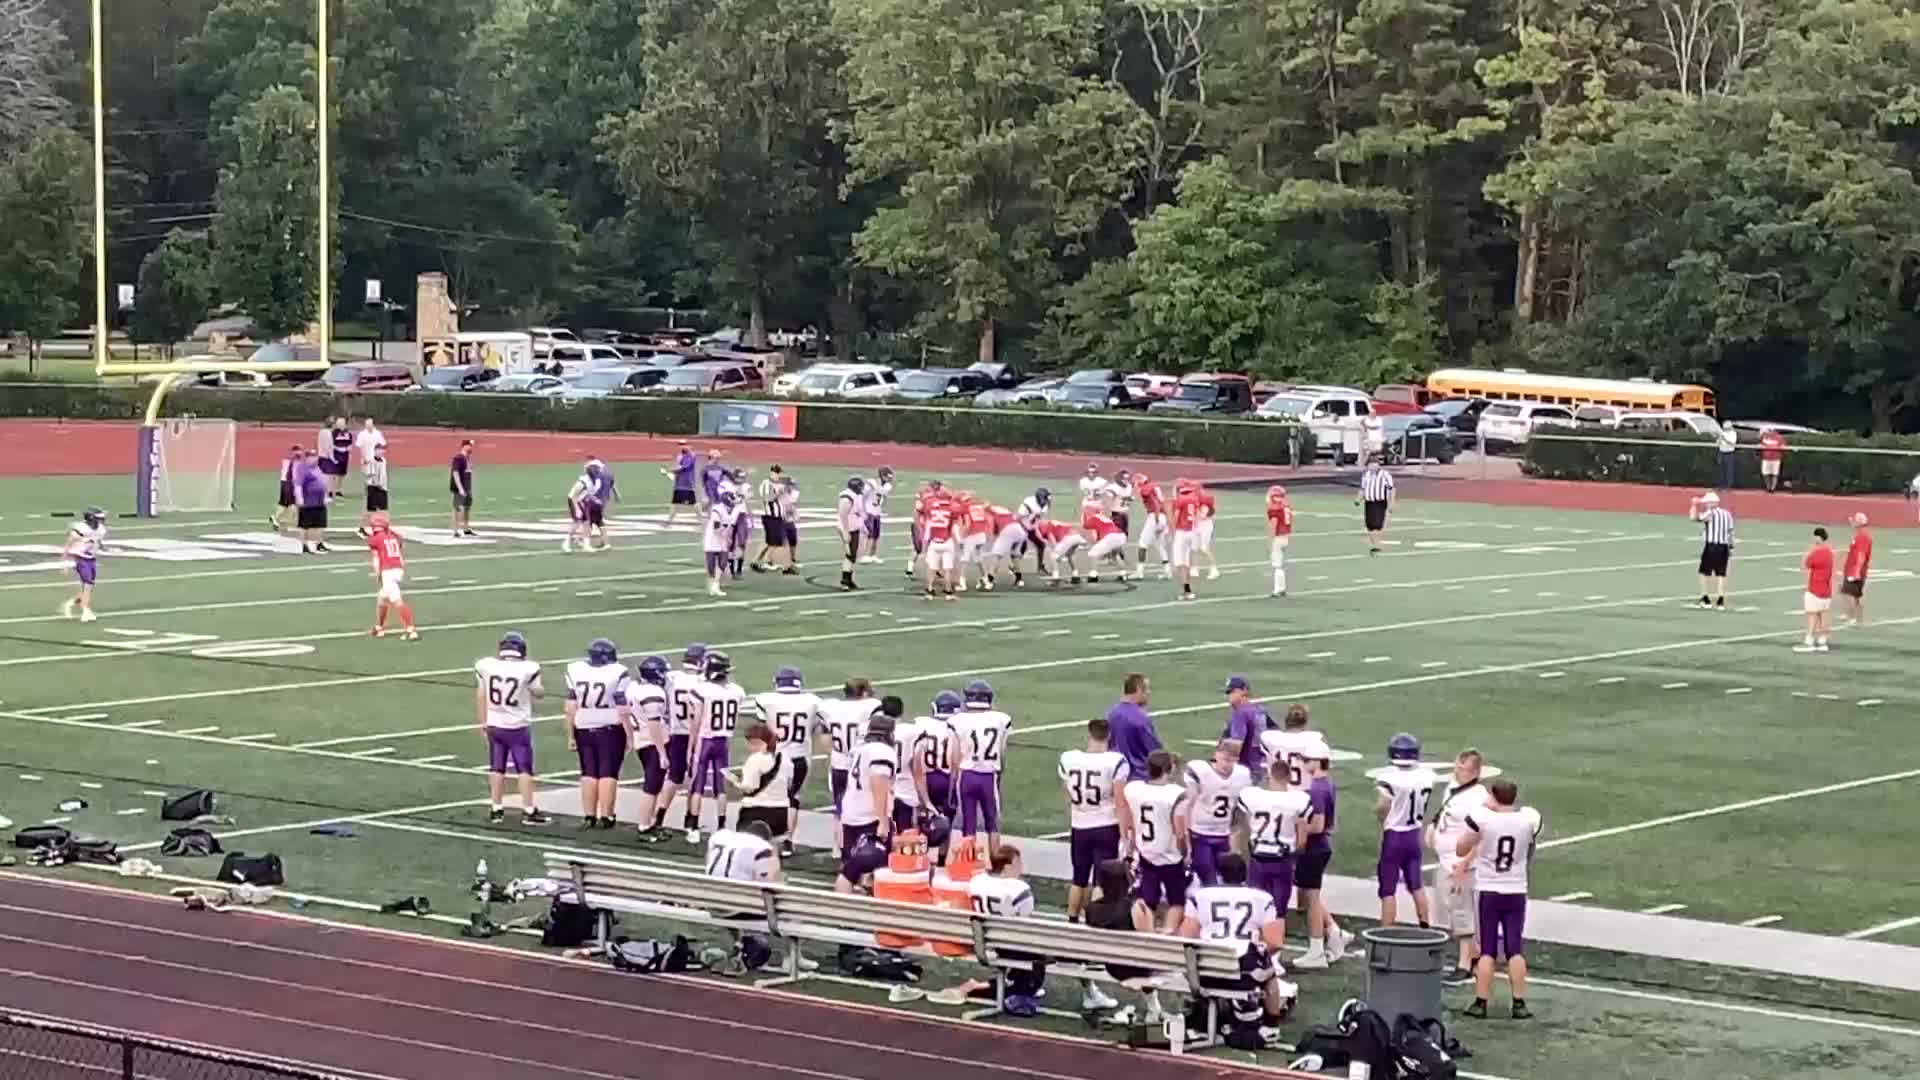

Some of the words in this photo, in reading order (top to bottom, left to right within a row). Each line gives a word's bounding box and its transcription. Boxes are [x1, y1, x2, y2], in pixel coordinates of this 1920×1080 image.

[384, 538, 402, 558] 10
[488, 675, 519, 707] 62
[576, 681, 610, 709] 72
[710, 699, 738, 731] 88
[775, 712, 808, 744] 56
[969, 727, 998, 762] 12
[1068, 769, 1102, 806] 35
[1213, 796, 1230, 818] 3
[1139, 805, 1156, 842] 5
[1253, 811, 1284, 842] 21
[1495, 836, 1516, 873] 8
[1210, 901, 1253, 940] 52
